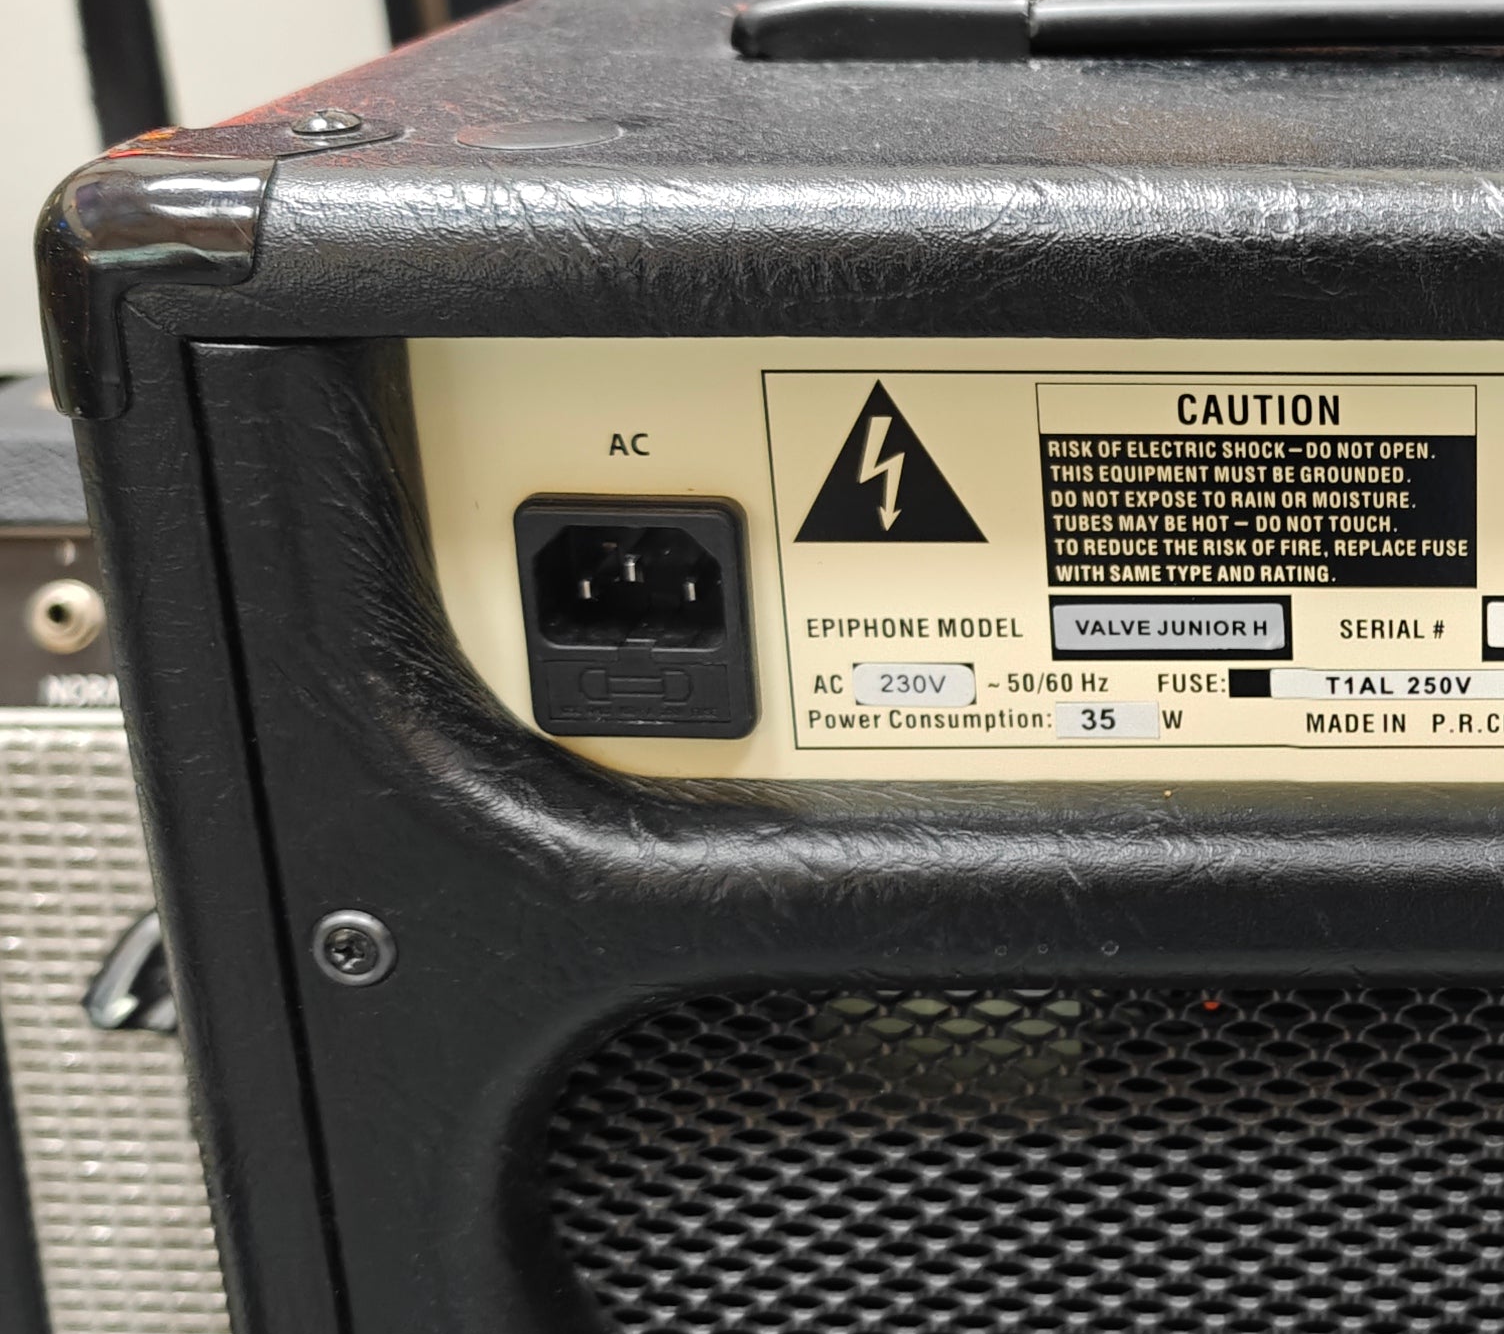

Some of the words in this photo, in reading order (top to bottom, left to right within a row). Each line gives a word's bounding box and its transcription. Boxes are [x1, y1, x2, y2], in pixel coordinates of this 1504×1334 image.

[1177, 393, 1340, 426] CAUTION
[609, 432, 650, 456] AC
[1047, 440, 1093, 458] RISK
[1097, 440, 1122, 459] OF
[1127, 440, 1217, 459] ELECTRIC
[1306, 441, 1332, 459] DO
[1337, 441, 1375, 460] NOT
[1379, 441, 1436, 460] OPEN.
[1049, 464, 1094, 483] THIS
[1098, 464, 1209, 483] EQUIPMENT
[1214, 465, 1268, 483] MUST
[1272, 465, 1295, 483] BE
[1300, 465, 1411, 484] GROUNDED.
[1050, 490, 1077, 508] DO
[1081, 490, 1120, 508] NOT
[1124, 490, 1198, 509] EXPOSE
[1201, 490, 1226, 509] TO
[1230, 491, 1276, 509] RAIN
[1281, 490, 1307, 509] OR
[1312, 491, 1416, 509] MOISTURE.
[1052, 514, 1114, 532] TUBES
[1118, 514, 1159, 532] MAY
[1164, 514, 1187, 532] BE
[1191, 514, 1230, 533] HOT
[1255, 515, 1282, 533] DO
[1286, 515, 1324, 533] NOT
[1328, 515, 1398, 533] TOUCH.
[1054, 538, 1079, 556] TO
[1083, 538, 1159, 556] REDUCE
[1162, 538, 1198, 556] THE
[1202, 538, 1247, 557] RISK
[1251, 538, 1275, 557] OF
[1280, 539, 1329, 558] FIRE,
[1334, 539, 1417, 557] REPLACE
[1421, 539, 1468, 557] FUSE
[1055, 564, 1105, 582] WITH
[1109, 564, 1162, 583] SAME
[1165, 564, 1213, 582] TYPE
[1217, 565, 1255, 582] AND
[1260, 565, 1336, 583] RATING.
[806, 617, 930, 639] EPIPHONE
[937, 617, 1024, 638] MODEL
[1075, 619, 1151, 636] VALVE
[1157, 620, 1247, 636] JUNIOR
[1253, 620, 1267, 636] H
[1340, 619, 1425, 640] SERIAL
[813, 674, 843, 695] AC
[880, 673, 946, 694] 230V
[1007, 673, 1073, 694] 50/60
[1081, 672, 1109, 693] Hz
[1157, 673, 1226, 693] FUSE:
[1325, 676, 1394, 695] T1AL
[1407, 676, 1472, 695] 250V
[808, 709, 881, 729] Power
[889, 709, 1052, 733] Consumption:
[1081, 708, 1116, 731] 35
[1161, 710, 1183, 730] W
[1306, 712, 1375, 733] MADE
[1383, 713, 1406, 733] IN
